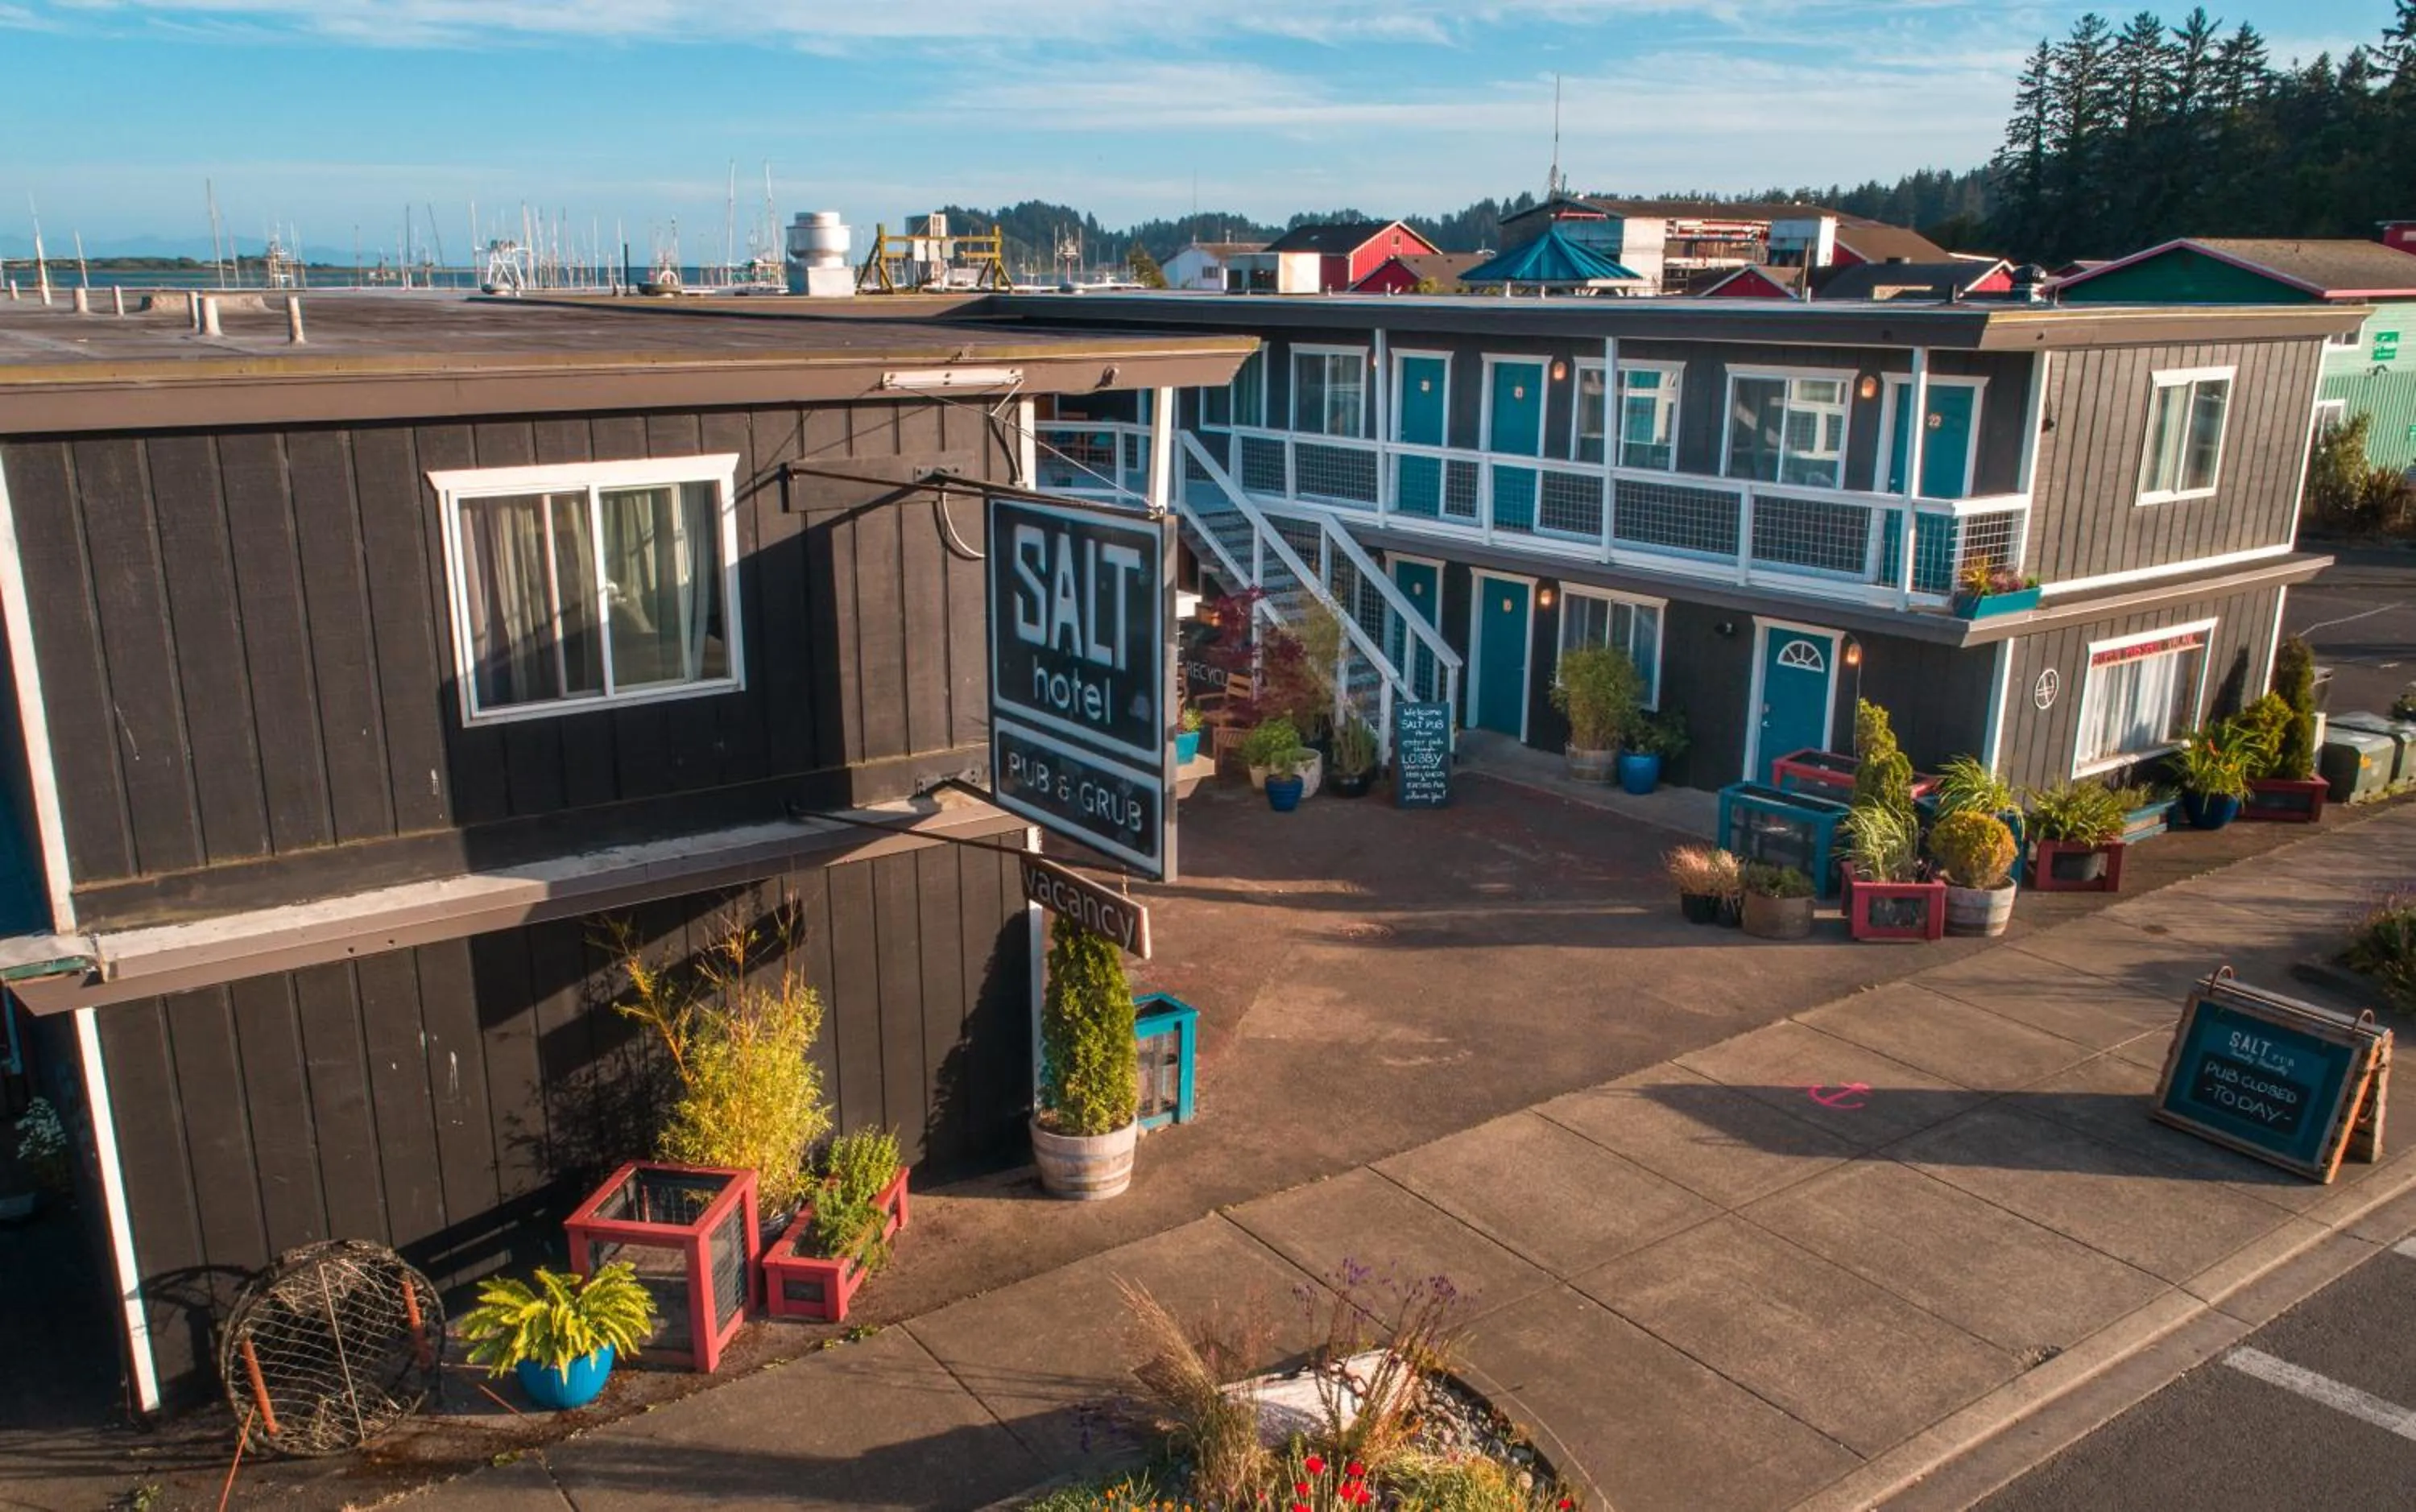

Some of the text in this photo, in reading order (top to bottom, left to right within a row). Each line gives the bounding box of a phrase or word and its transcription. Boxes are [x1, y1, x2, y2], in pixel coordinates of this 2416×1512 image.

[1015, 523, 1141, 671] SALT
[1032, 655, 1111, 725] hotel
[1186, 660, 1229, 686] RECYCL
[1402, 753, 1444, 766] LOBBY
[1008, 750, 1143, 833] PUB & GRUB
[1023, 861, 1134, 951] vacancy
[2228, 1031, 2272, 1057] SALT
[2204, 1060, 2239, 1083] PUB
[2240, 1076, 2298, 1104] CLOSED
